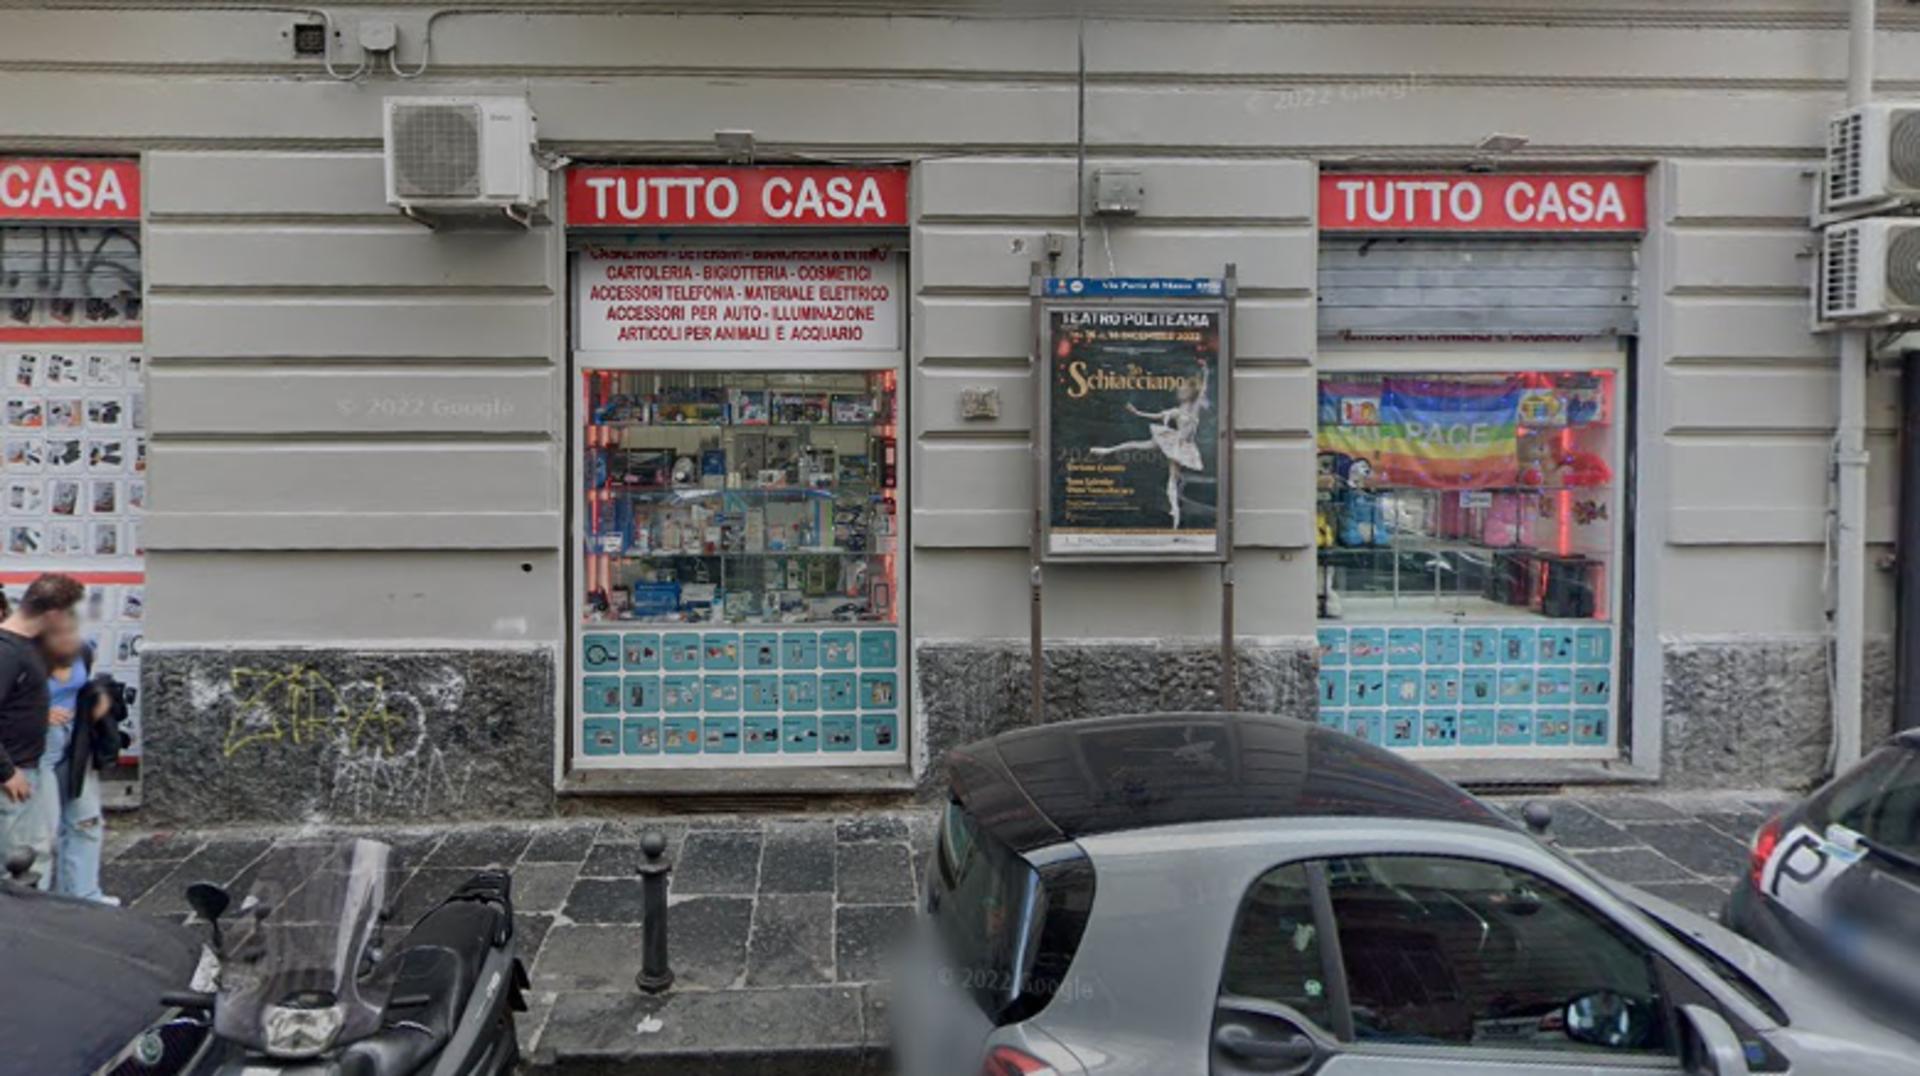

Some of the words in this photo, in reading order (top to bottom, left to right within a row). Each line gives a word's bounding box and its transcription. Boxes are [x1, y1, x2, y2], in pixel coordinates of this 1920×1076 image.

[0, 166, 127, 210] CASA
[586, 177, 739, 219] TUTTO
[762, 177, 887, 219] CASA
[1337, 181, 1483, 222] TUTTO
[1505, 181, 1626, 222] CASA
[606, 265, 693, 281] CARTOLERIA
[703, 265, 788, 281] BIGIOTTERIA
[798, 265, 872, 281] COSMETICI
[590, 285, 663, 301] ACCESSORI
[666, 285, 734, 301] TELEFONIA
[744, 285, 815, 301] MATERIALE
[819, 285, 889, 301] ELETTRICO
[606, 305, 685, 321] ACCESSORI
[691, 305, 717, 321] PER
[723, 305, 761, 321] AUTO
[771, 305, 875, 321] ILLUMINAZIONE
[1062, 311, 1121, 326] TEATRO
[1123, 312, 1210, 327] POLITEAMA
[617, 326, 681, 341] ARTICOLI
[684, 326, 711, 341] PER
[714, 326, 769, 341] ANIMALI
[776, 326, 785, 341] E
[790, 326, 864, 342] ACQUARIO
[1066, 360, 1202, 398] Schiacciano
[1405, 422, 1489, 448] PACE
